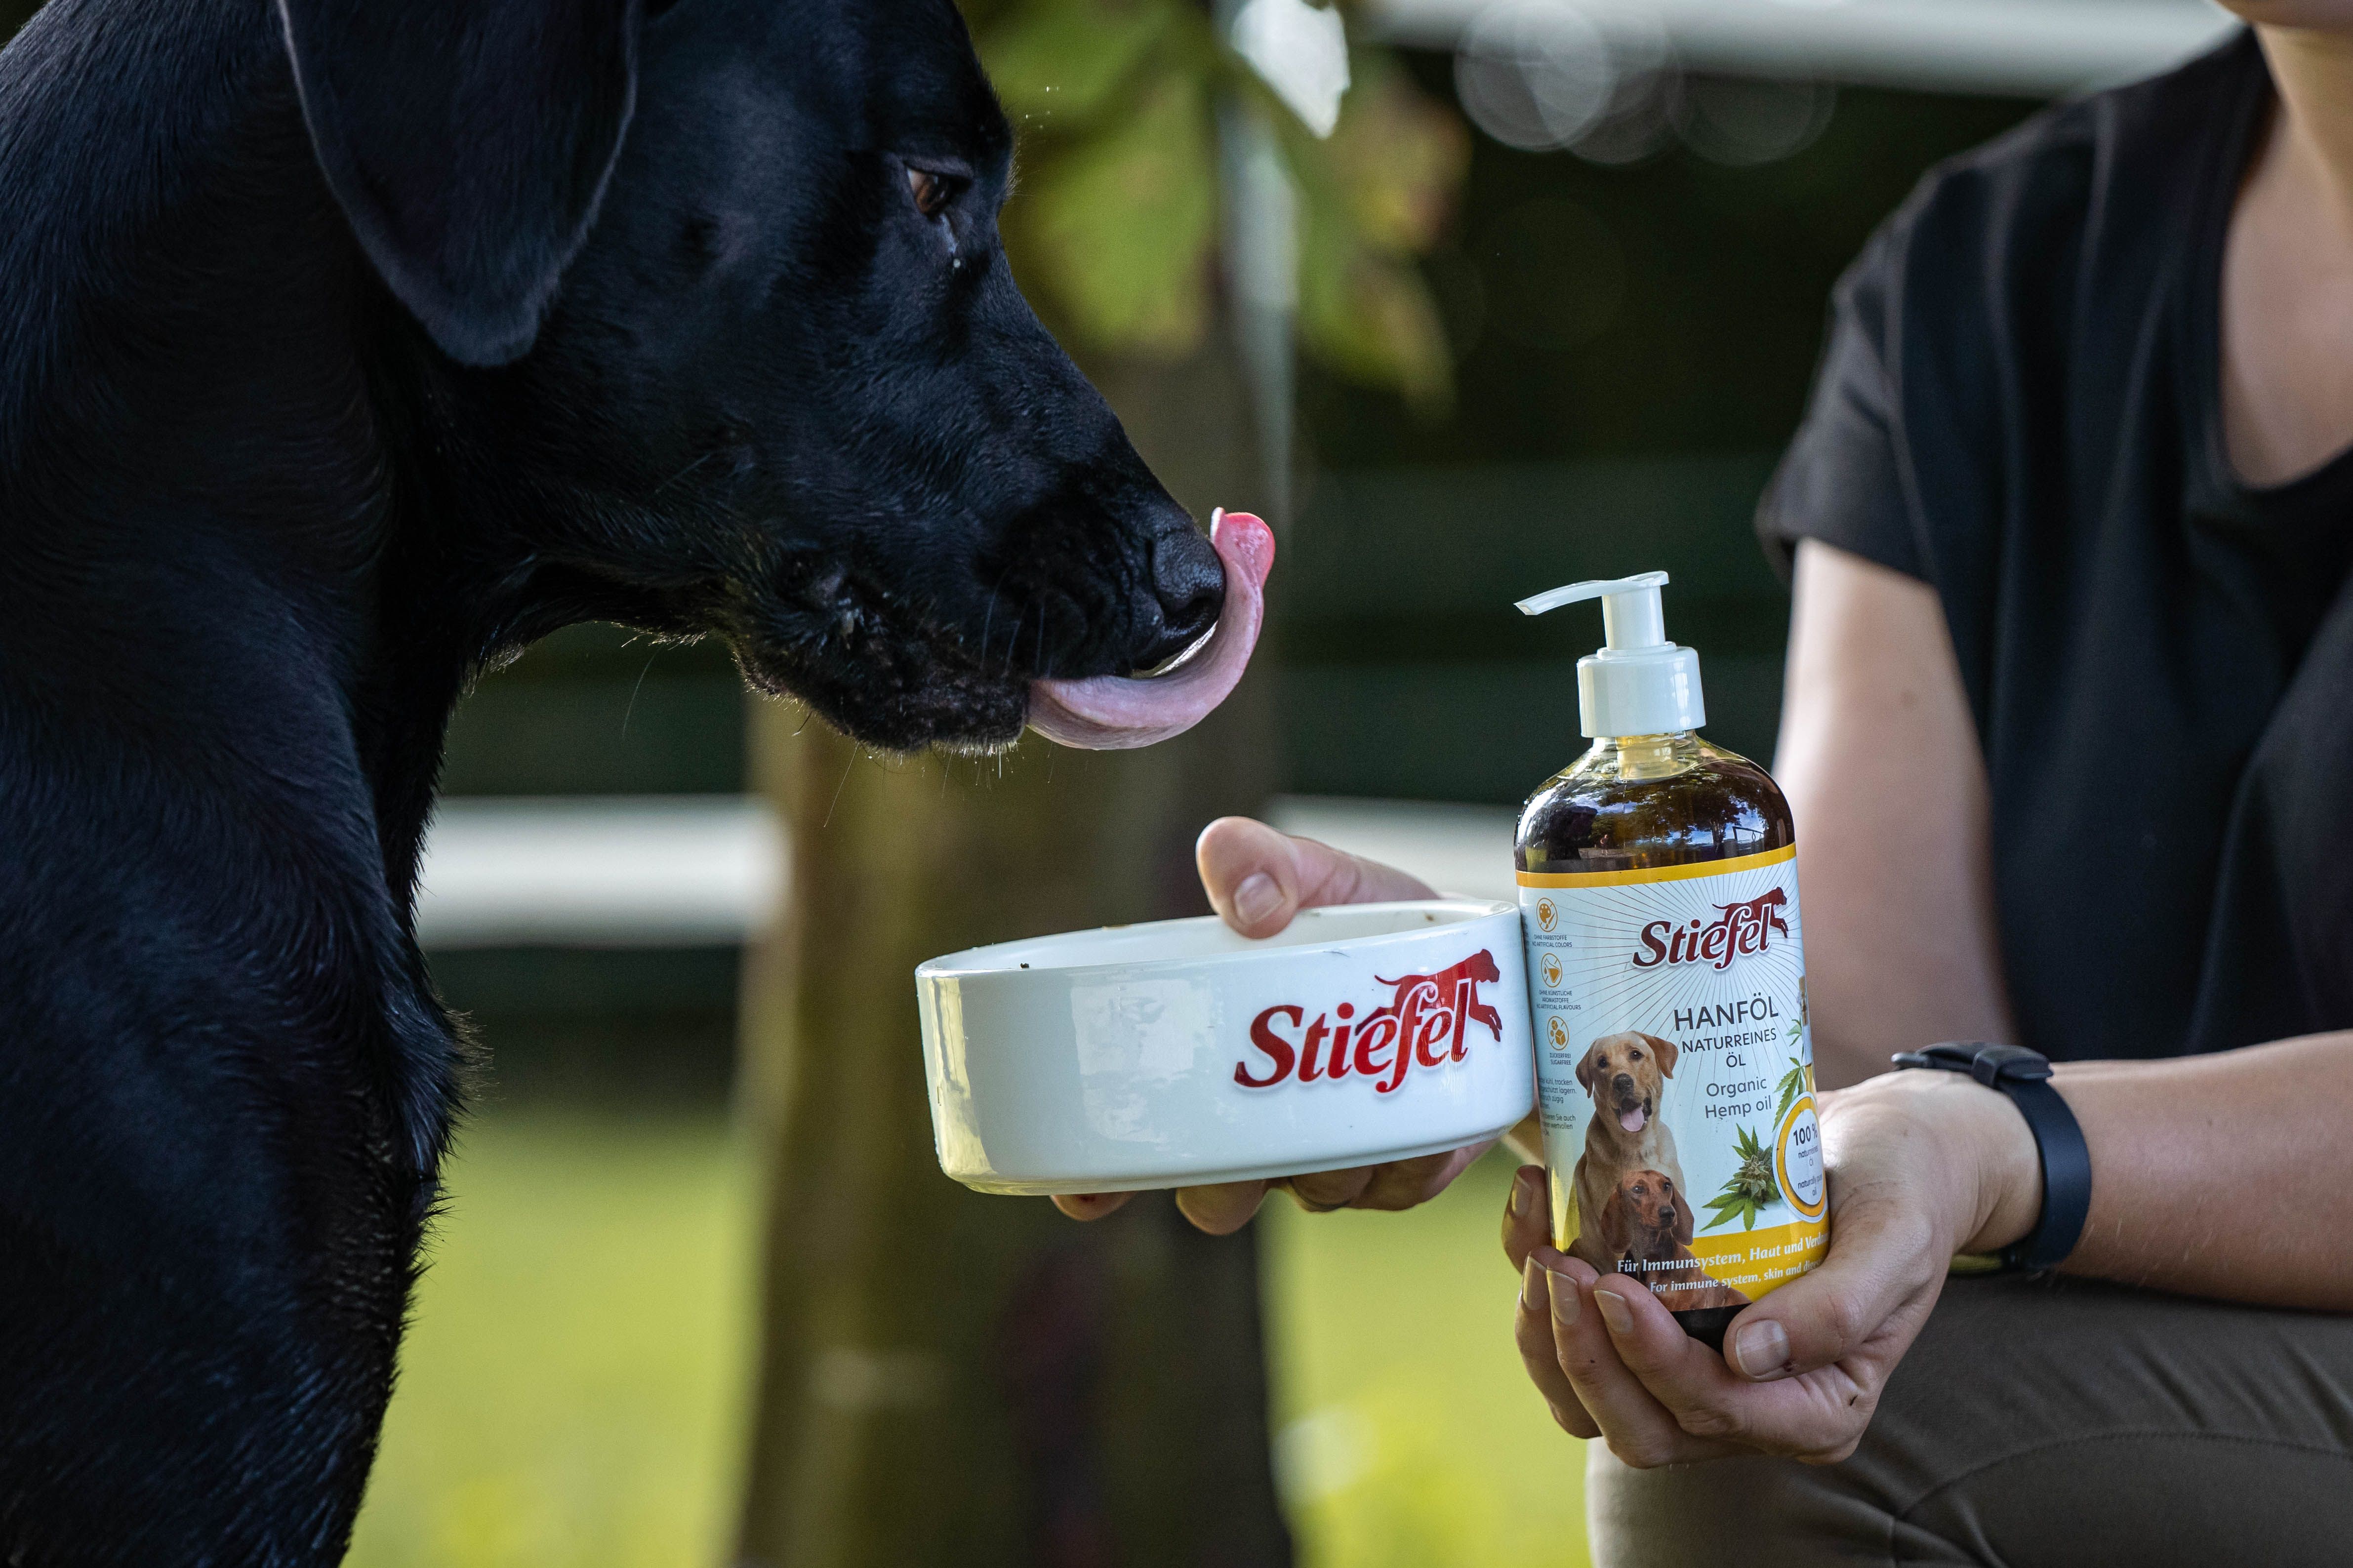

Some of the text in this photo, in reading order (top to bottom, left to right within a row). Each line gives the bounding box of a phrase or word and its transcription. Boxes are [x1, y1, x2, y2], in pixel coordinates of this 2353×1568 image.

[1632, 904, 1771, 970] Stiefel
[1674, 992, 1779, 1031] HANFÖL
[1234, 979, 1470, 1093] Stiefel
[1682, 1028, 1777, 1053] NATURREINES
[1726, 1052, 1746, 1068] ÖL
[1706, 1077, 1767, 1098] Organic
[1705, 1095, 1772, 1119] Hemp oil
[1793, 1126, 1811, 1146] 100
[1617, 1259, 1638, 1273] Für
[1643, 1252, 1746, 1272] Immunsystem,
[1749, 1245, 1781, 1261] Haut
[1784, 1238, 1803, 1254] und
[1650, 1282, 1667, 1292] For
[1671, 1279, 1719, 1291] immune
[1721, 1274, 1761, 1288] system,
[1764, 1268, 1784, 1280] skin
[1785, 1262, 1801, 1275] and
